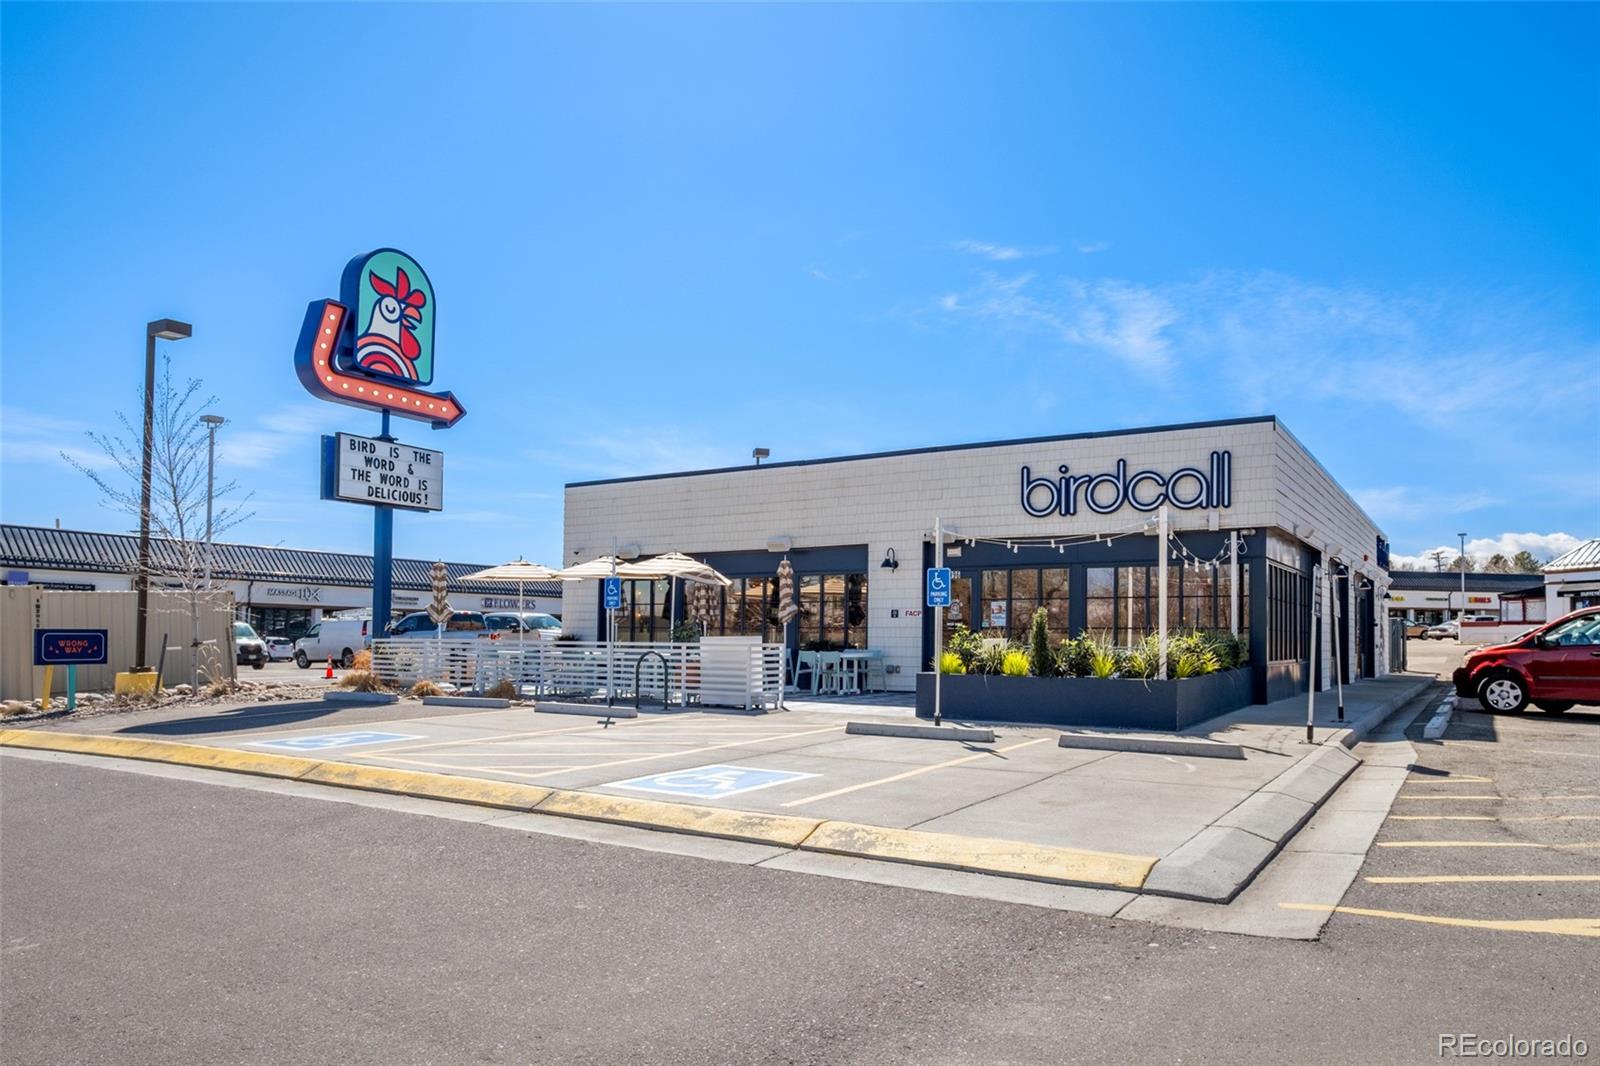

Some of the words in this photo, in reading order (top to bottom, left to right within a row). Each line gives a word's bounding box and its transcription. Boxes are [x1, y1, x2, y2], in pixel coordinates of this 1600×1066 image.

[349, 438, 376, 454] BIRD
[389, 446, 400, 459] IS
[413, 450, 431, 465] THE
[364, 455, 395, 472] WORD
[407, 463, 414, 475] &
[351, 468, 371, 483] THE
[380, 472, 410, 489] WORD
[418, 479, 428, 491] IS
[1021, 450, 1232, 518] birdcall
[367, 485, 428, 505] DELICIOUS!
[58, 639, 88, 647] WRONG
[64, 646, 82, 654] WAY
